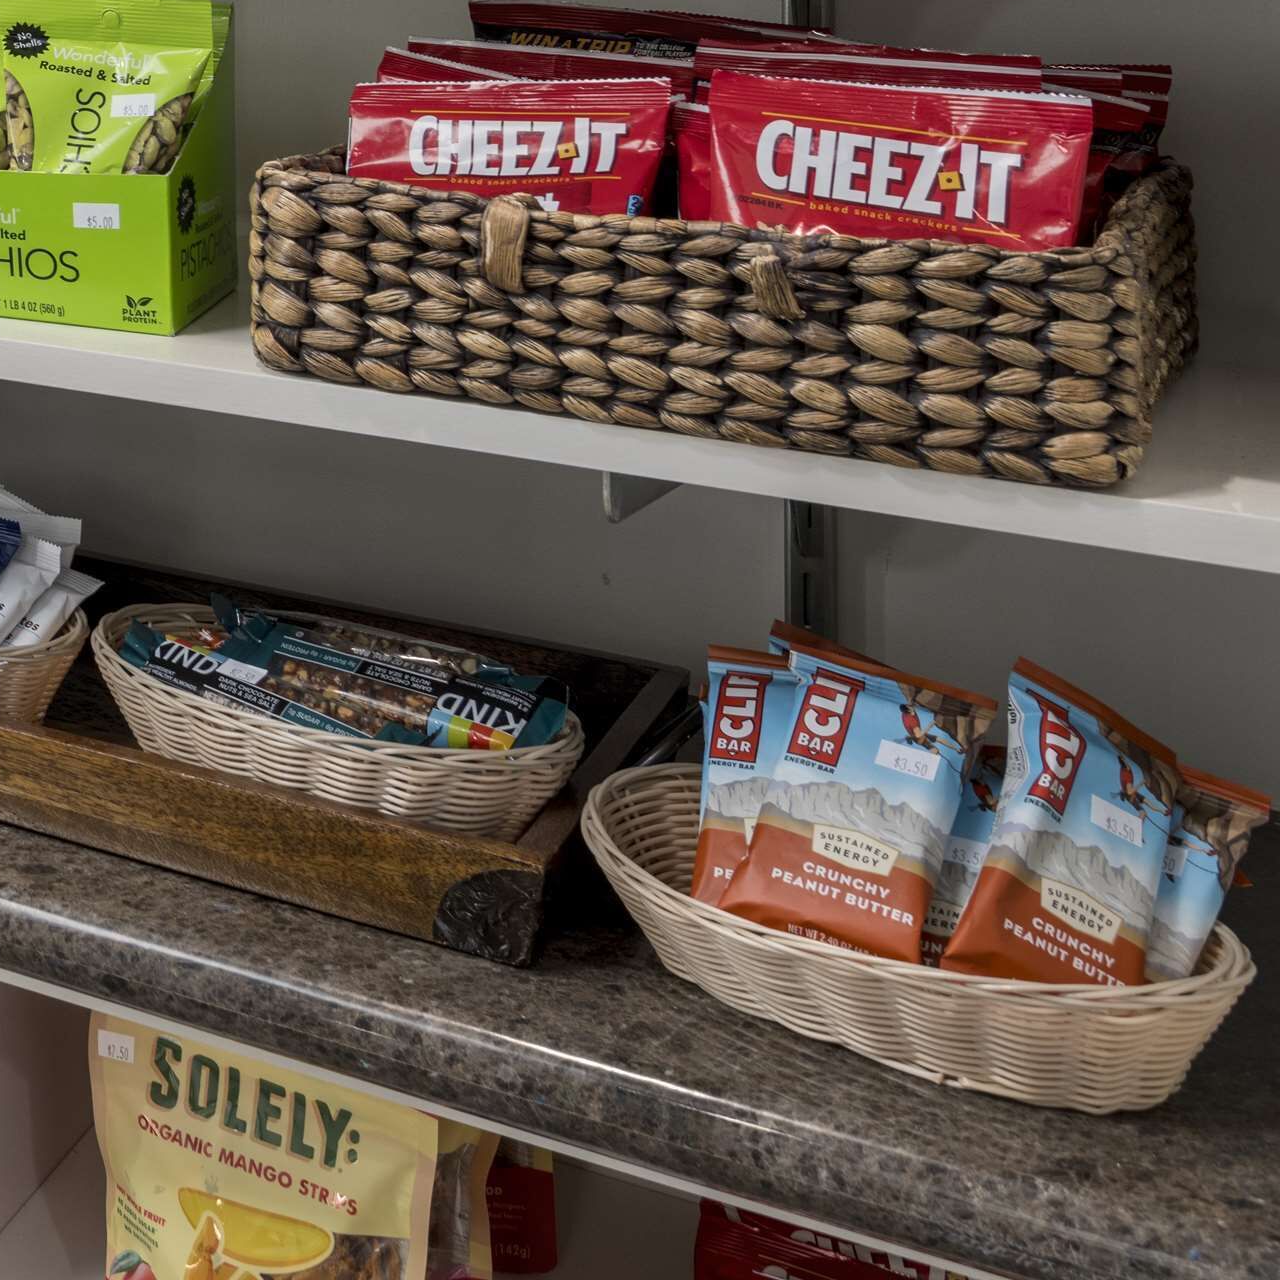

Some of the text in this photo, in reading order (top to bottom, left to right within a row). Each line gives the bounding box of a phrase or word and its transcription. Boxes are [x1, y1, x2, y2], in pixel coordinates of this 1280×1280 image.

[39, 61, 93, 82] Roasted
[809, 202, 958, 232] baked snack crackers
[122, 309, 158, 318] PLANT
[716, 738, 751, 753] BAR
[797, 732, 835, 755] BAR
[893, 756, 929, 776] $3.50
[820, 831, 890, 860] SUSTAINED
[823, 843, 879, 867] ENERGY
[802, 861, 890, 899] CRUNCHY
[771, 866, 914, 927] PEANUT BUTTER
[1048, 887, 1114, 927] SUSTAINED
[1051, 899, 1104, 934] ENERGY
[1004, 918, 1070, 961] PEANUT
[1032, 916, 1115, 968] CRUNCHY
[138, 1113, 358, 1216] ORGANIC MANGO STRIPS
